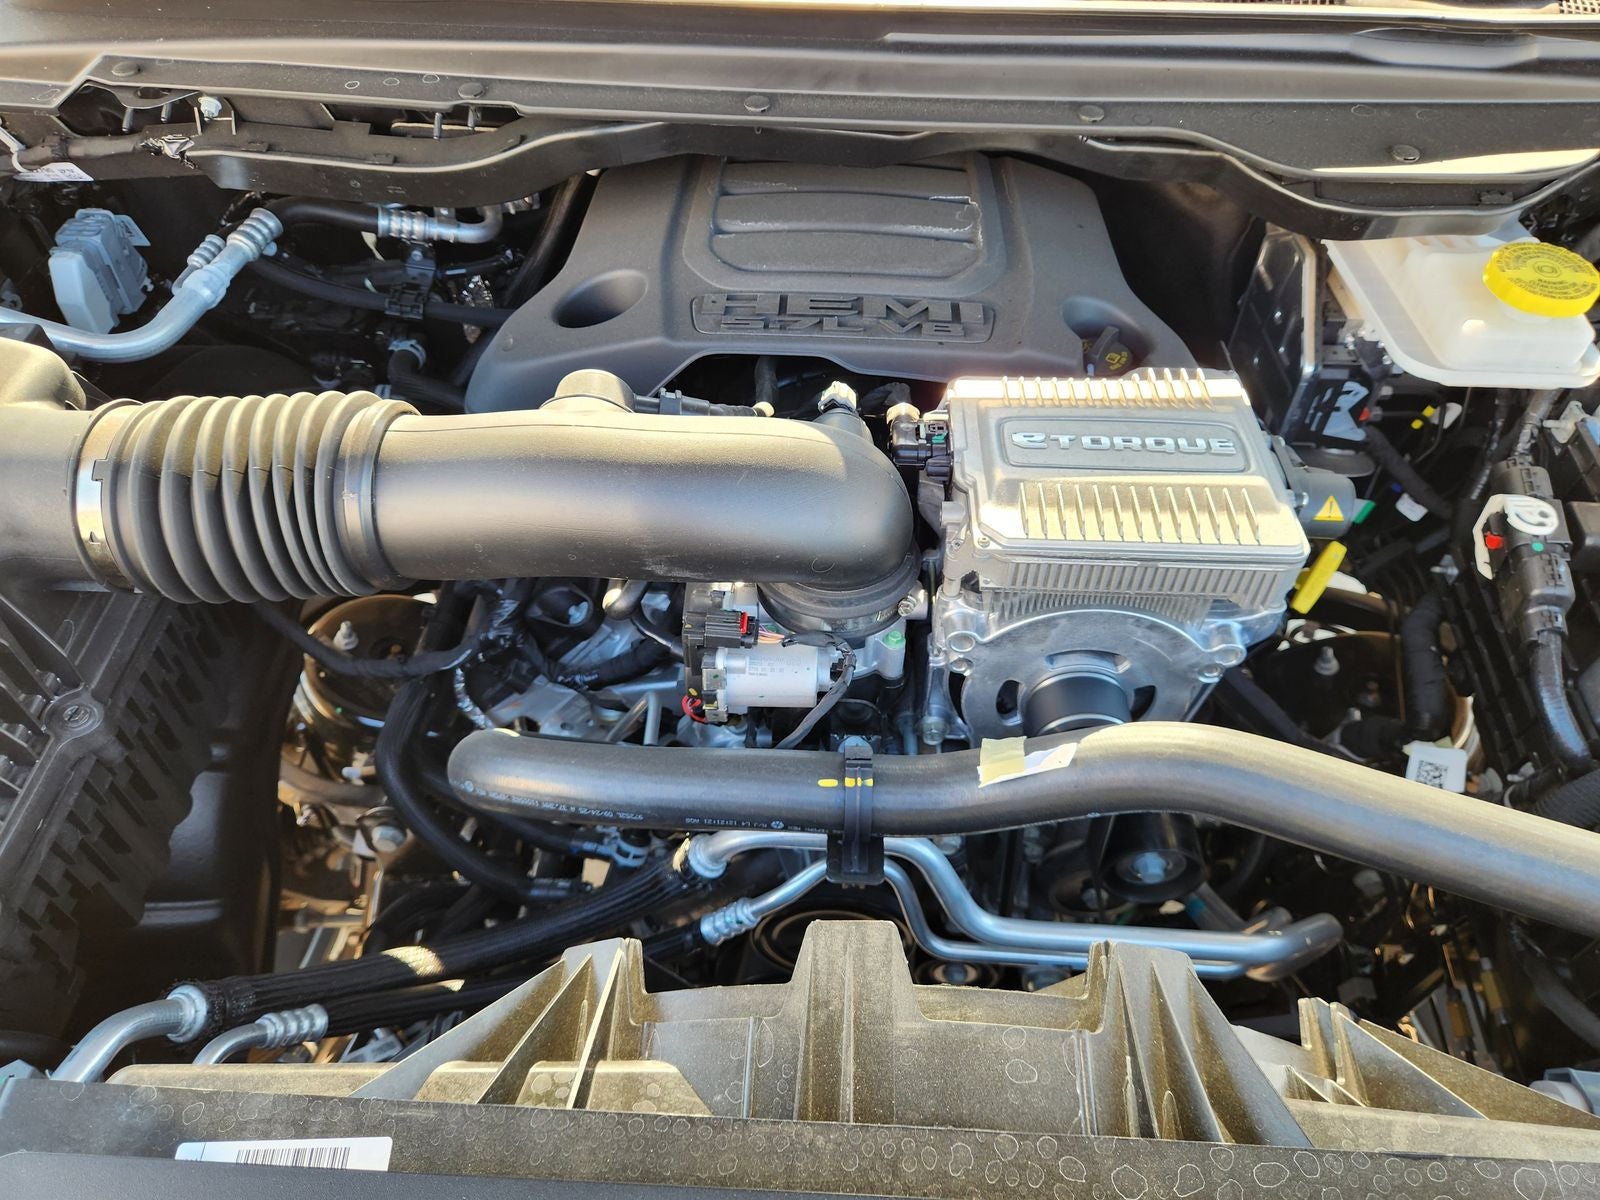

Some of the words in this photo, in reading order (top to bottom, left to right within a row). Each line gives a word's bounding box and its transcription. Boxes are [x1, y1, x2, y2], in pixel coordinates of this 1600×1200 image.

[701, 293, 985, 325] HEMI
[720, 316, 865, 332] 5.7L
[879, 319, 965, 337] V8
